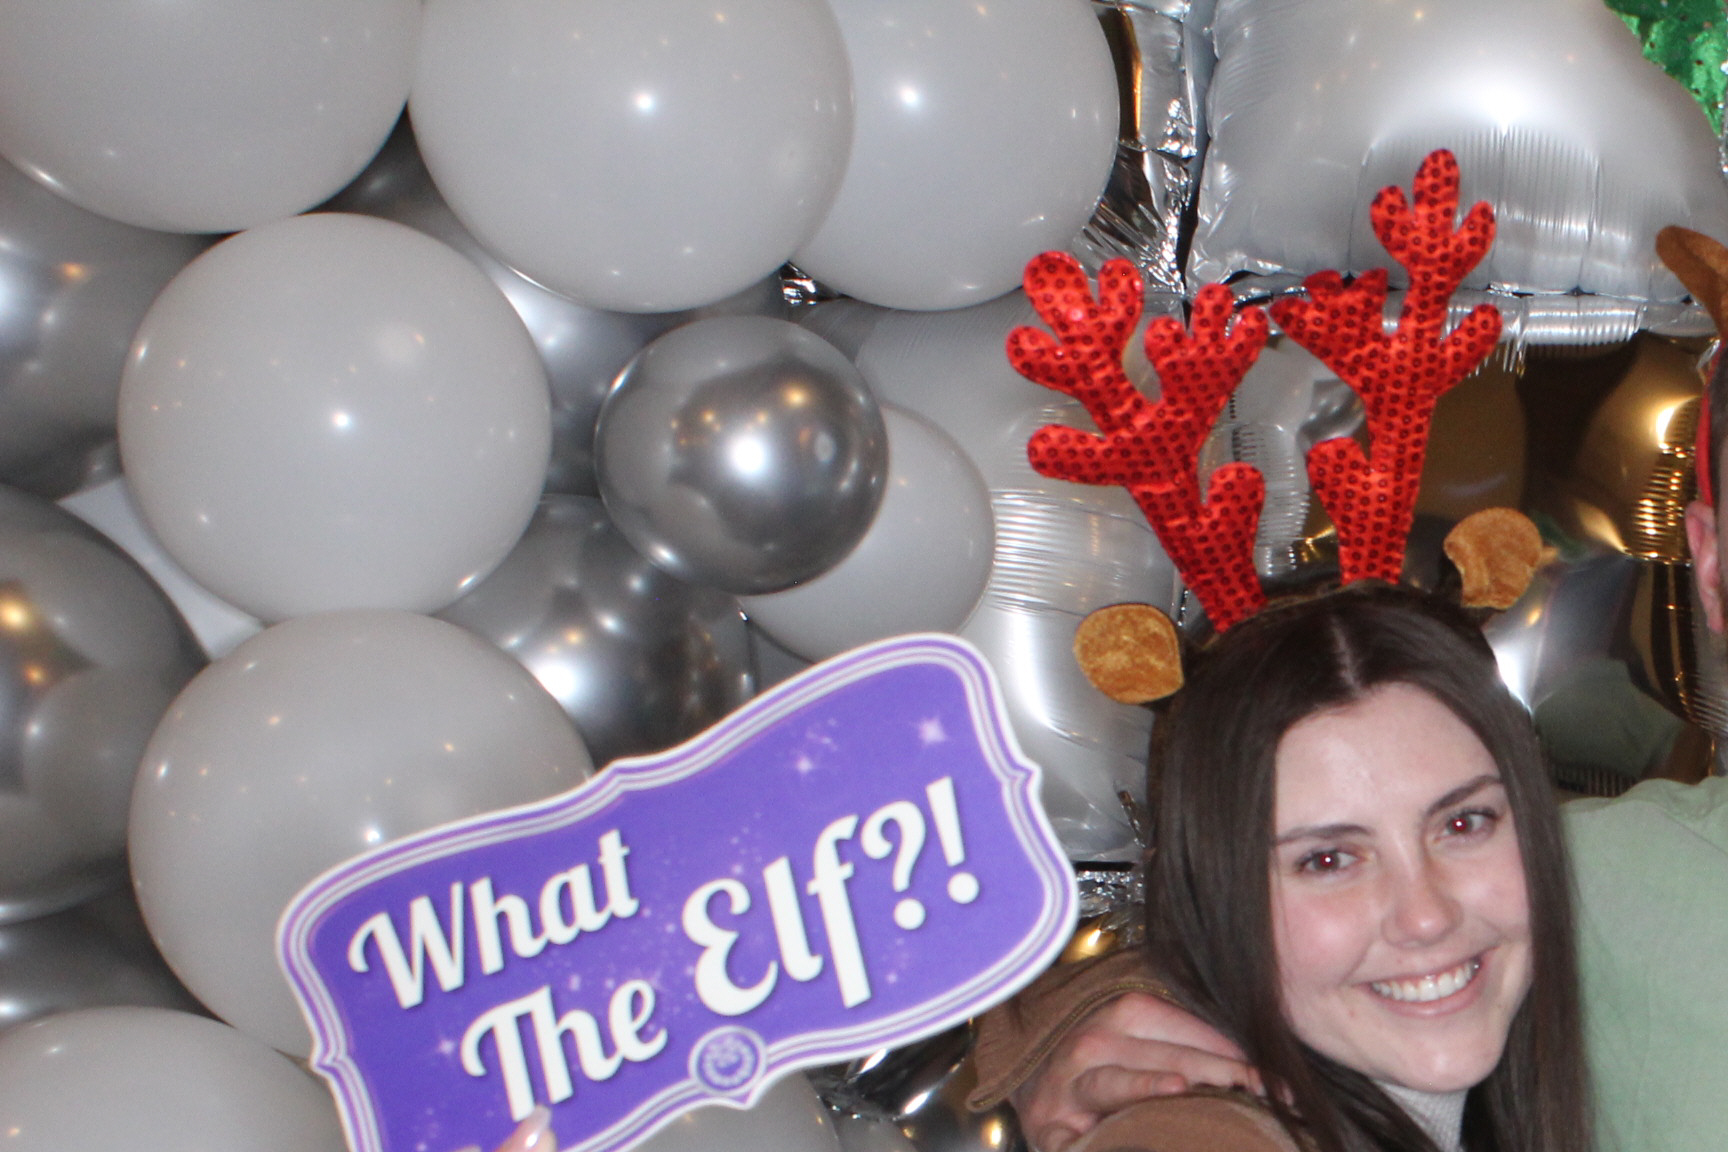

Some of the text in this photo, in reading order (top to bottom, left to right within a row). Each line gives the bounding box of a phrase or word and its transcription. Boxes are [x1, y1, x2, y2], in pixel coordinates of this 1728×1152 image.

[347, 828, 639, 1009] What
[460, 776, 980, 1123] The Elf?!
